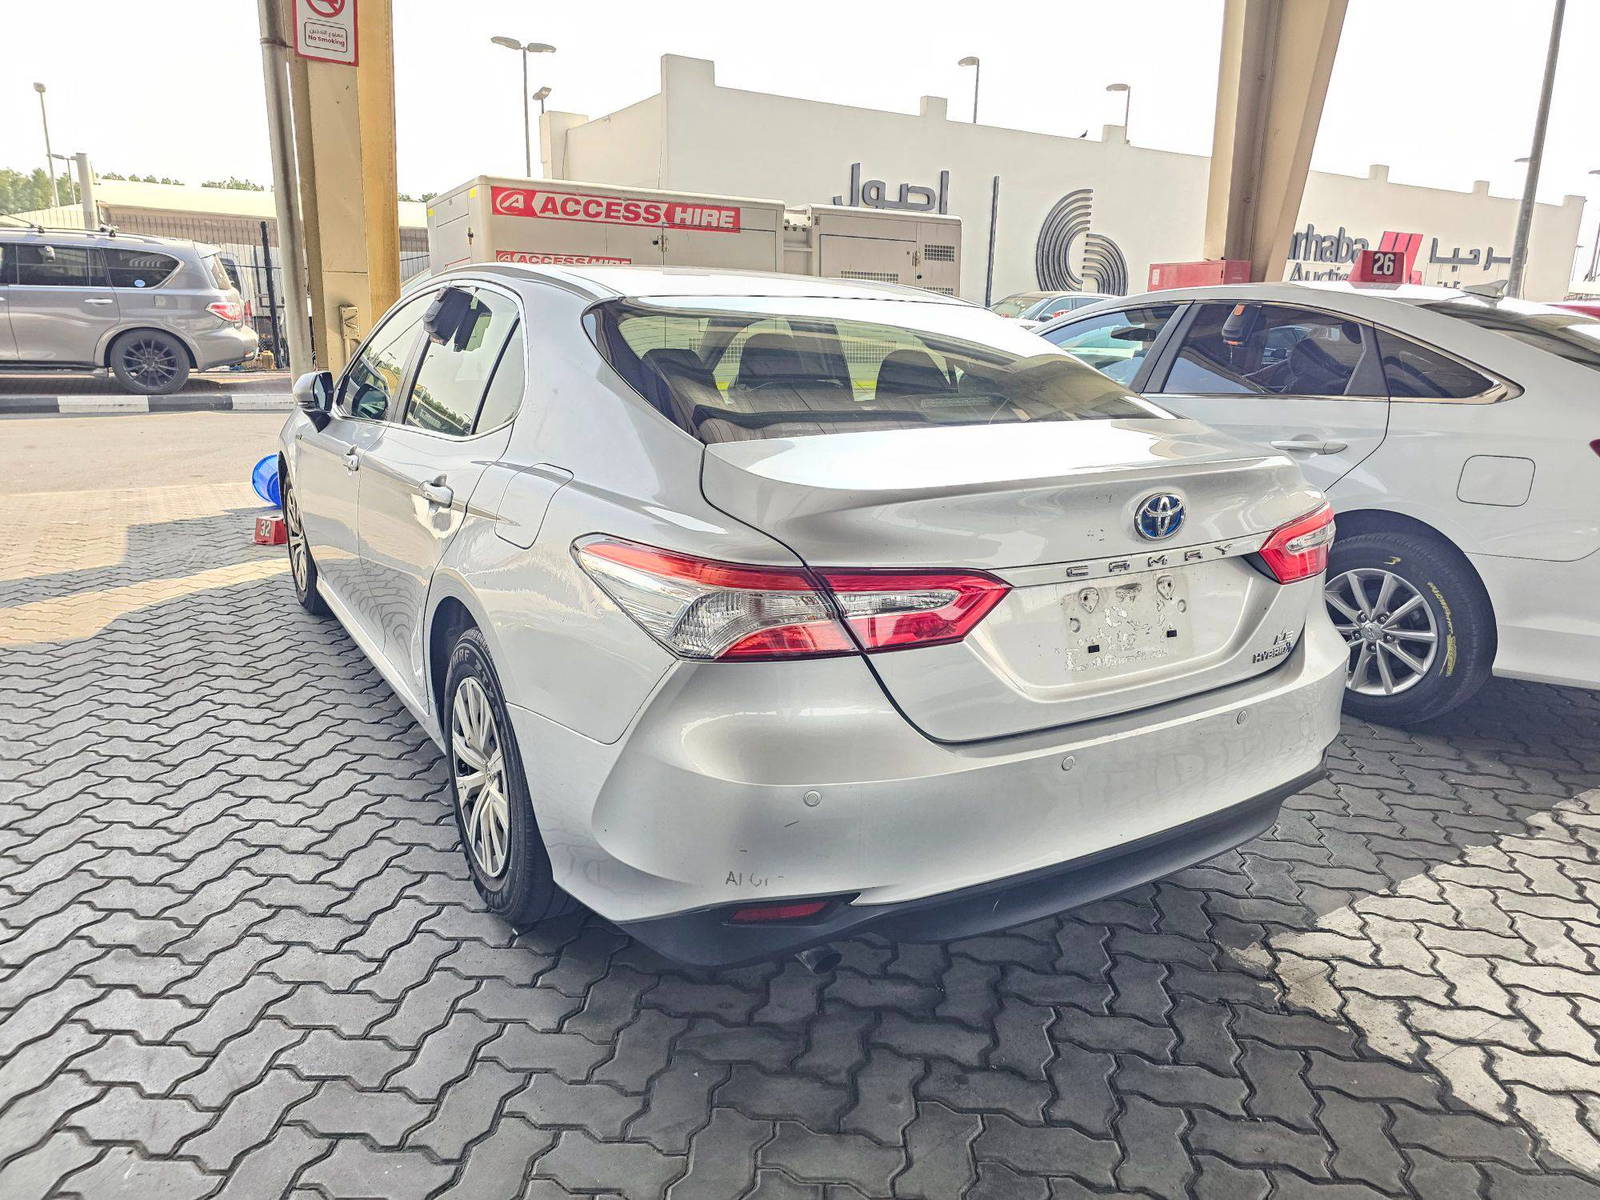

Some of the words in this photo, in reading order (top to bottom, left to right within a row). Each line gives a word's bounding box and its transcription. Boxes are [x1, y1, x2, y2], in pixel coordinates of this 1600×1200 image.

[318, 36, 345, 47] Smoking
[540, 196, 662, 223] ACCESS
[674, 207, 735, 228] HIRE
[1373, 253, 1395, 276] 26
[260, 520, 271, 537] 32
[1066, 543, 1232, 578] CAMRY
[1252, 642, 1292, 664] HYBRID
